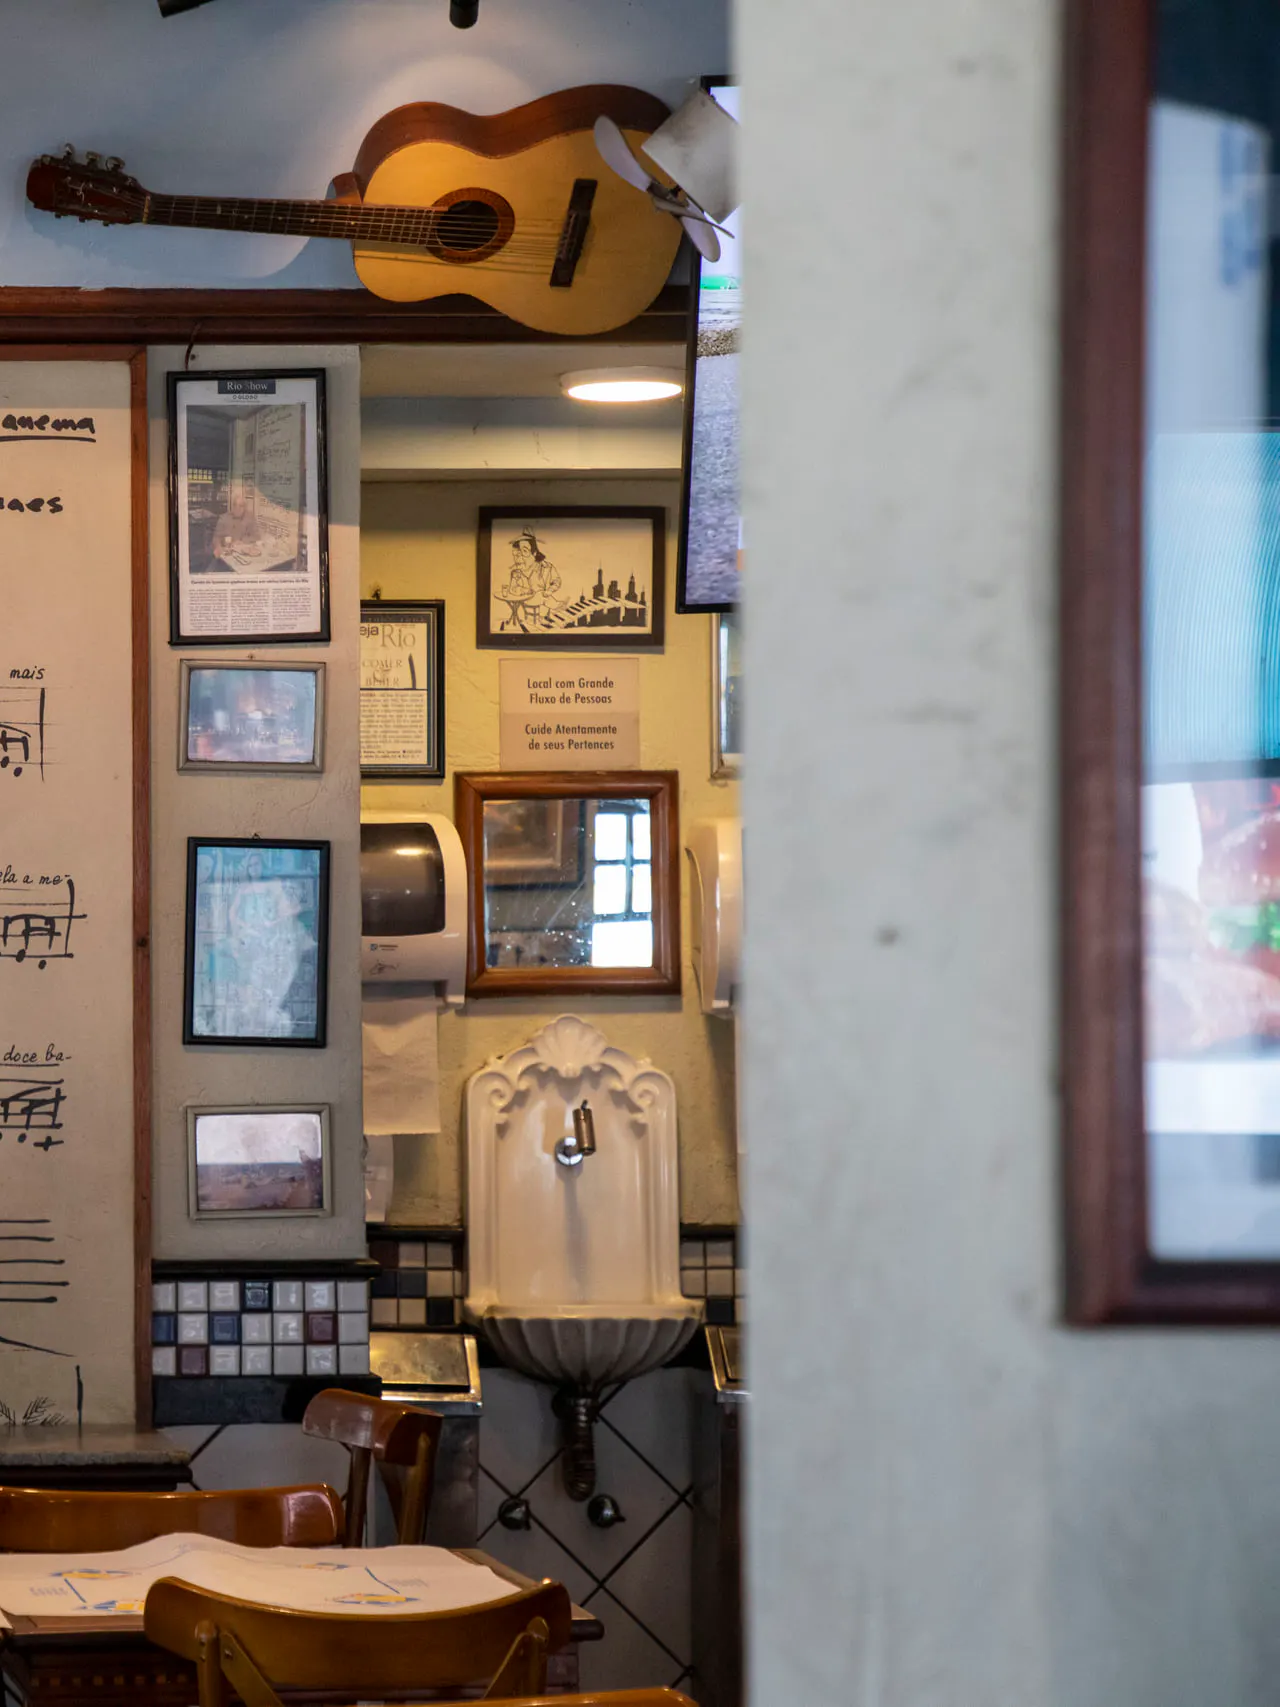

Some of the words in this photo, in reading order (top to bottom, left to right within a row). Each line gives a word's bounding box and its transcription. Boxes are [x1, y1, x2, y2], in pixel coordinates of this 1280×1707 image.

[227, 381, 242, 390] Rio
[360, 623, 379, 639] eja
[380, 624, 416, 648] Rio
[10, 665, 45, 680] mais
[527, 677, 552, 689] Local
[555, 680, 575, 689] com
[578, 676, 614, 689] Grande
[530, 693, 556, 704] Fluxo
[559, 692, 571, 704] de
[575, 693, 612, 704] Pessoas
[525, 723, 552, 735] Cuide
[555, 724, 617, 735] Atentamente
[528, 738, 540, 750] de
[544, 741, 565, 750] seus
[568, 739, 615, 750] Pertences
[22, 876, 33, 884] a
[3, 1044, 38, 1062] doce
